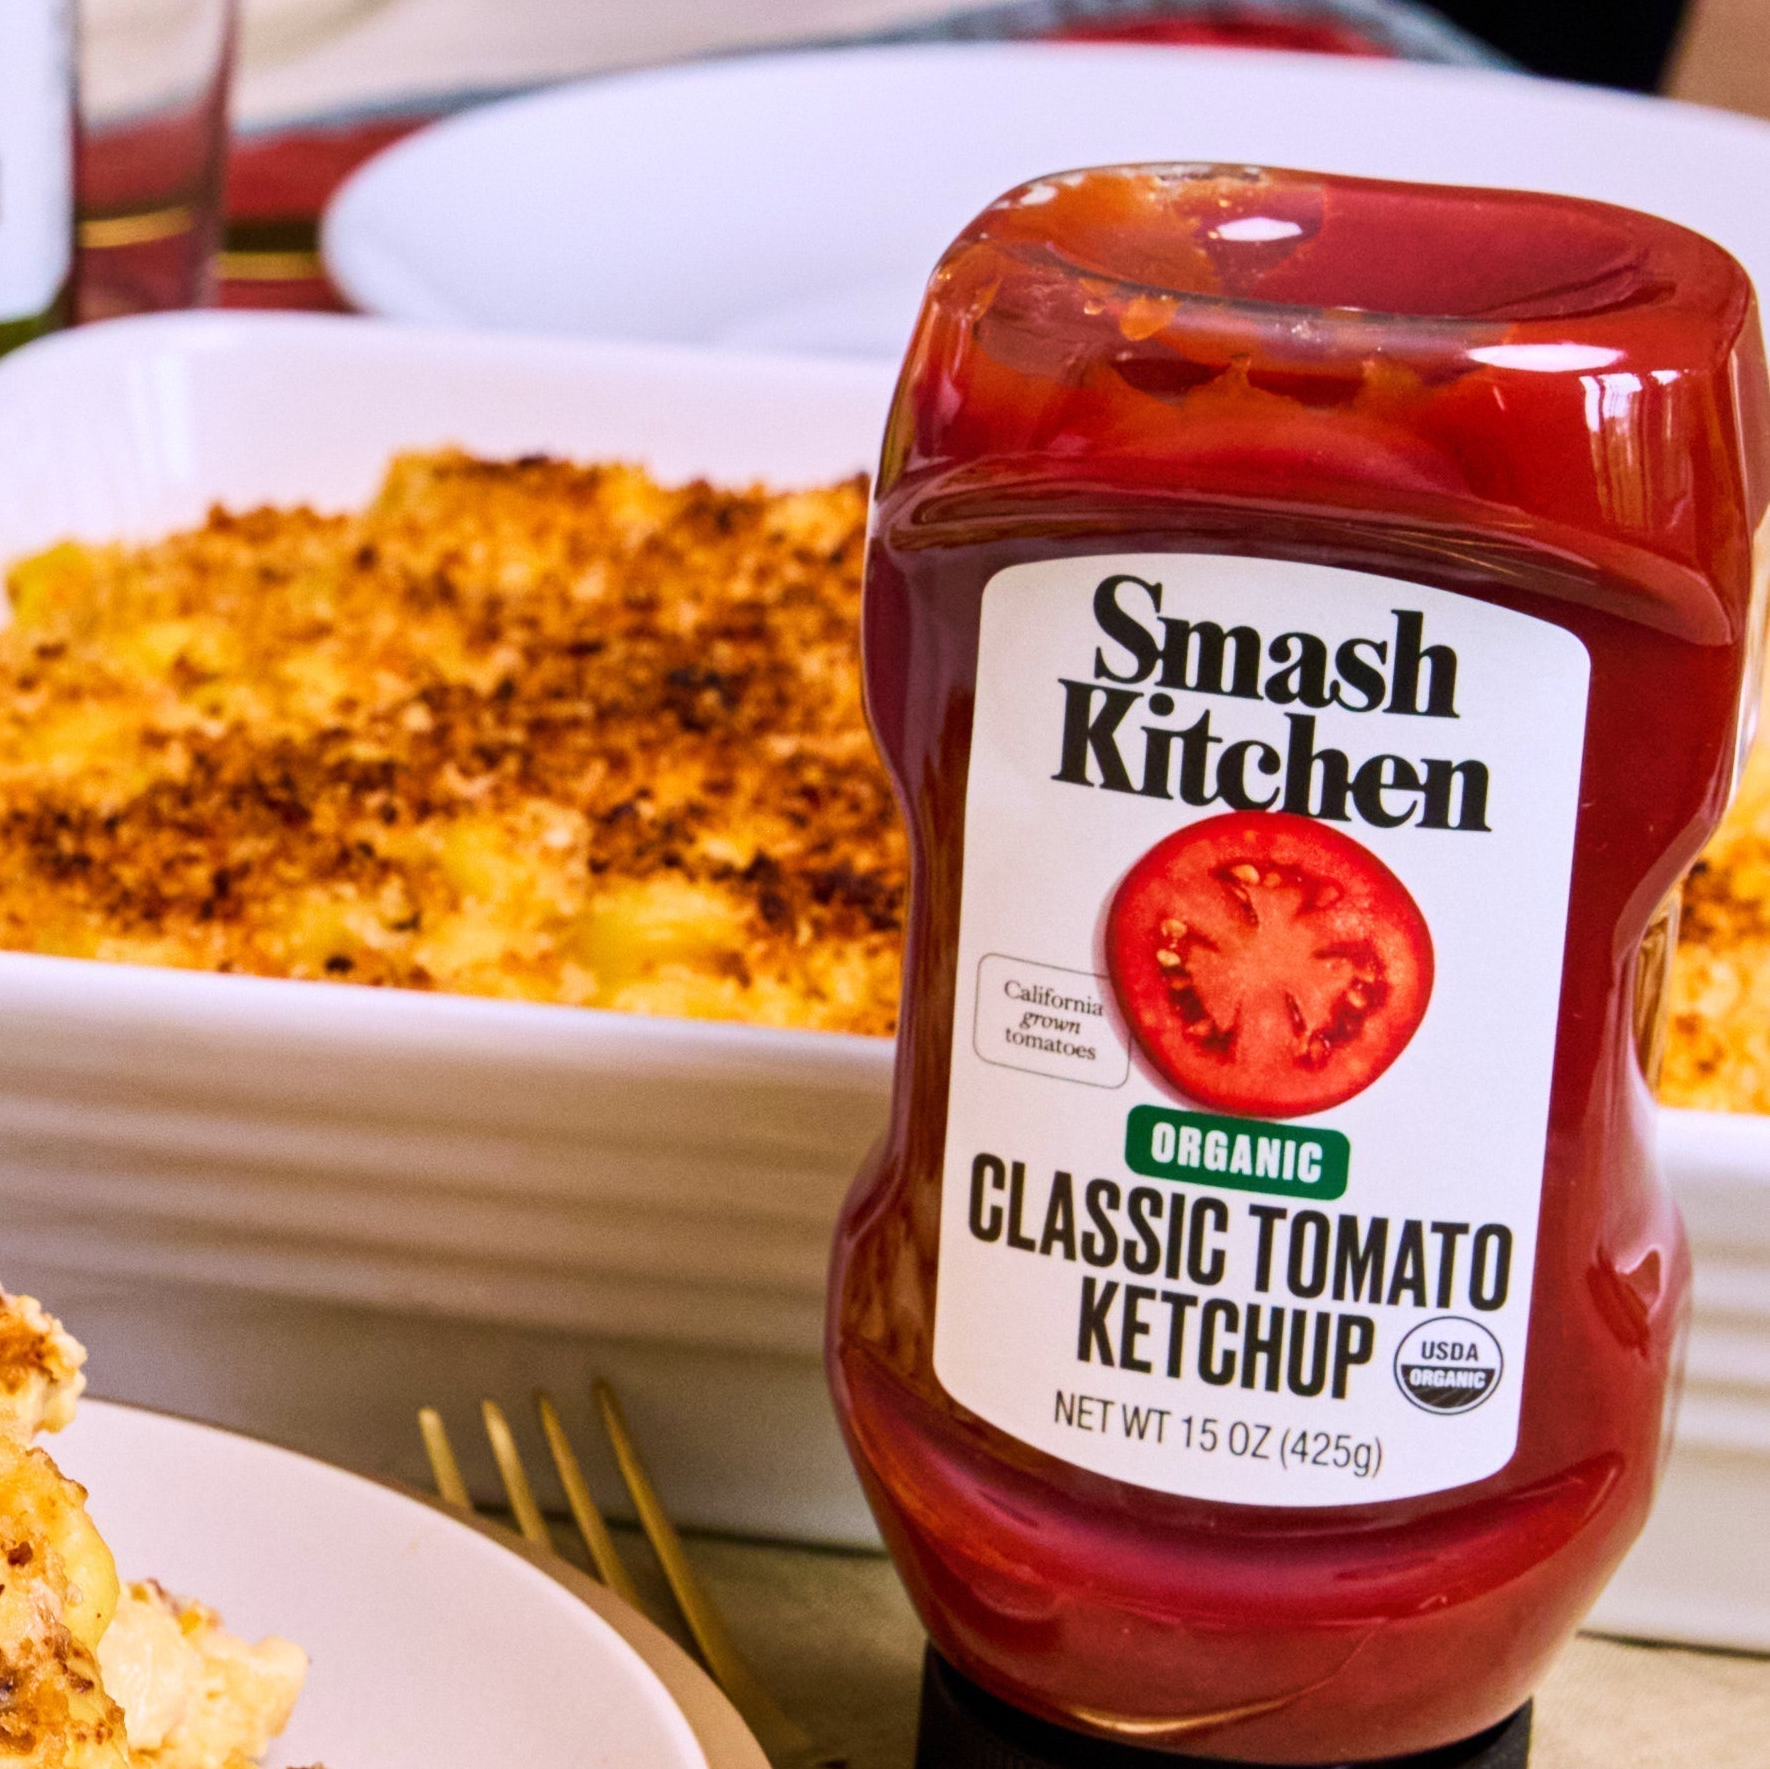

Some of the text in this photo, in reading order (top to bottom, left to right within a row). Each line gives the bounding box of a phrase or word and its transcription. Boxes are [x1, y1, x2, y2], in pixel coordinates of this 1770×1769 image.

[1092, 573, 1460, 719] Smash
[1050, 677, 1492, 832] Kitchen
[1004, 980, 1104, 1016] California
[1019, 1011, 1081, 1035] grown
[1005, 1028, 1097, 1060] tomatoes
[1150, 1121, 1324, 1184] ORGANIC
[968, 1152, 1513, 1312] CLASSIC TOMATO
[1077, 1276, 1375, 1400] KETCHUP
[1421, 1341, 1479, 1362] USDA
[1410, 1368, 1486, 1389] ORGANIC
[1054, 1390, 1382, 1479] NET WT 15 OZ (425g)
